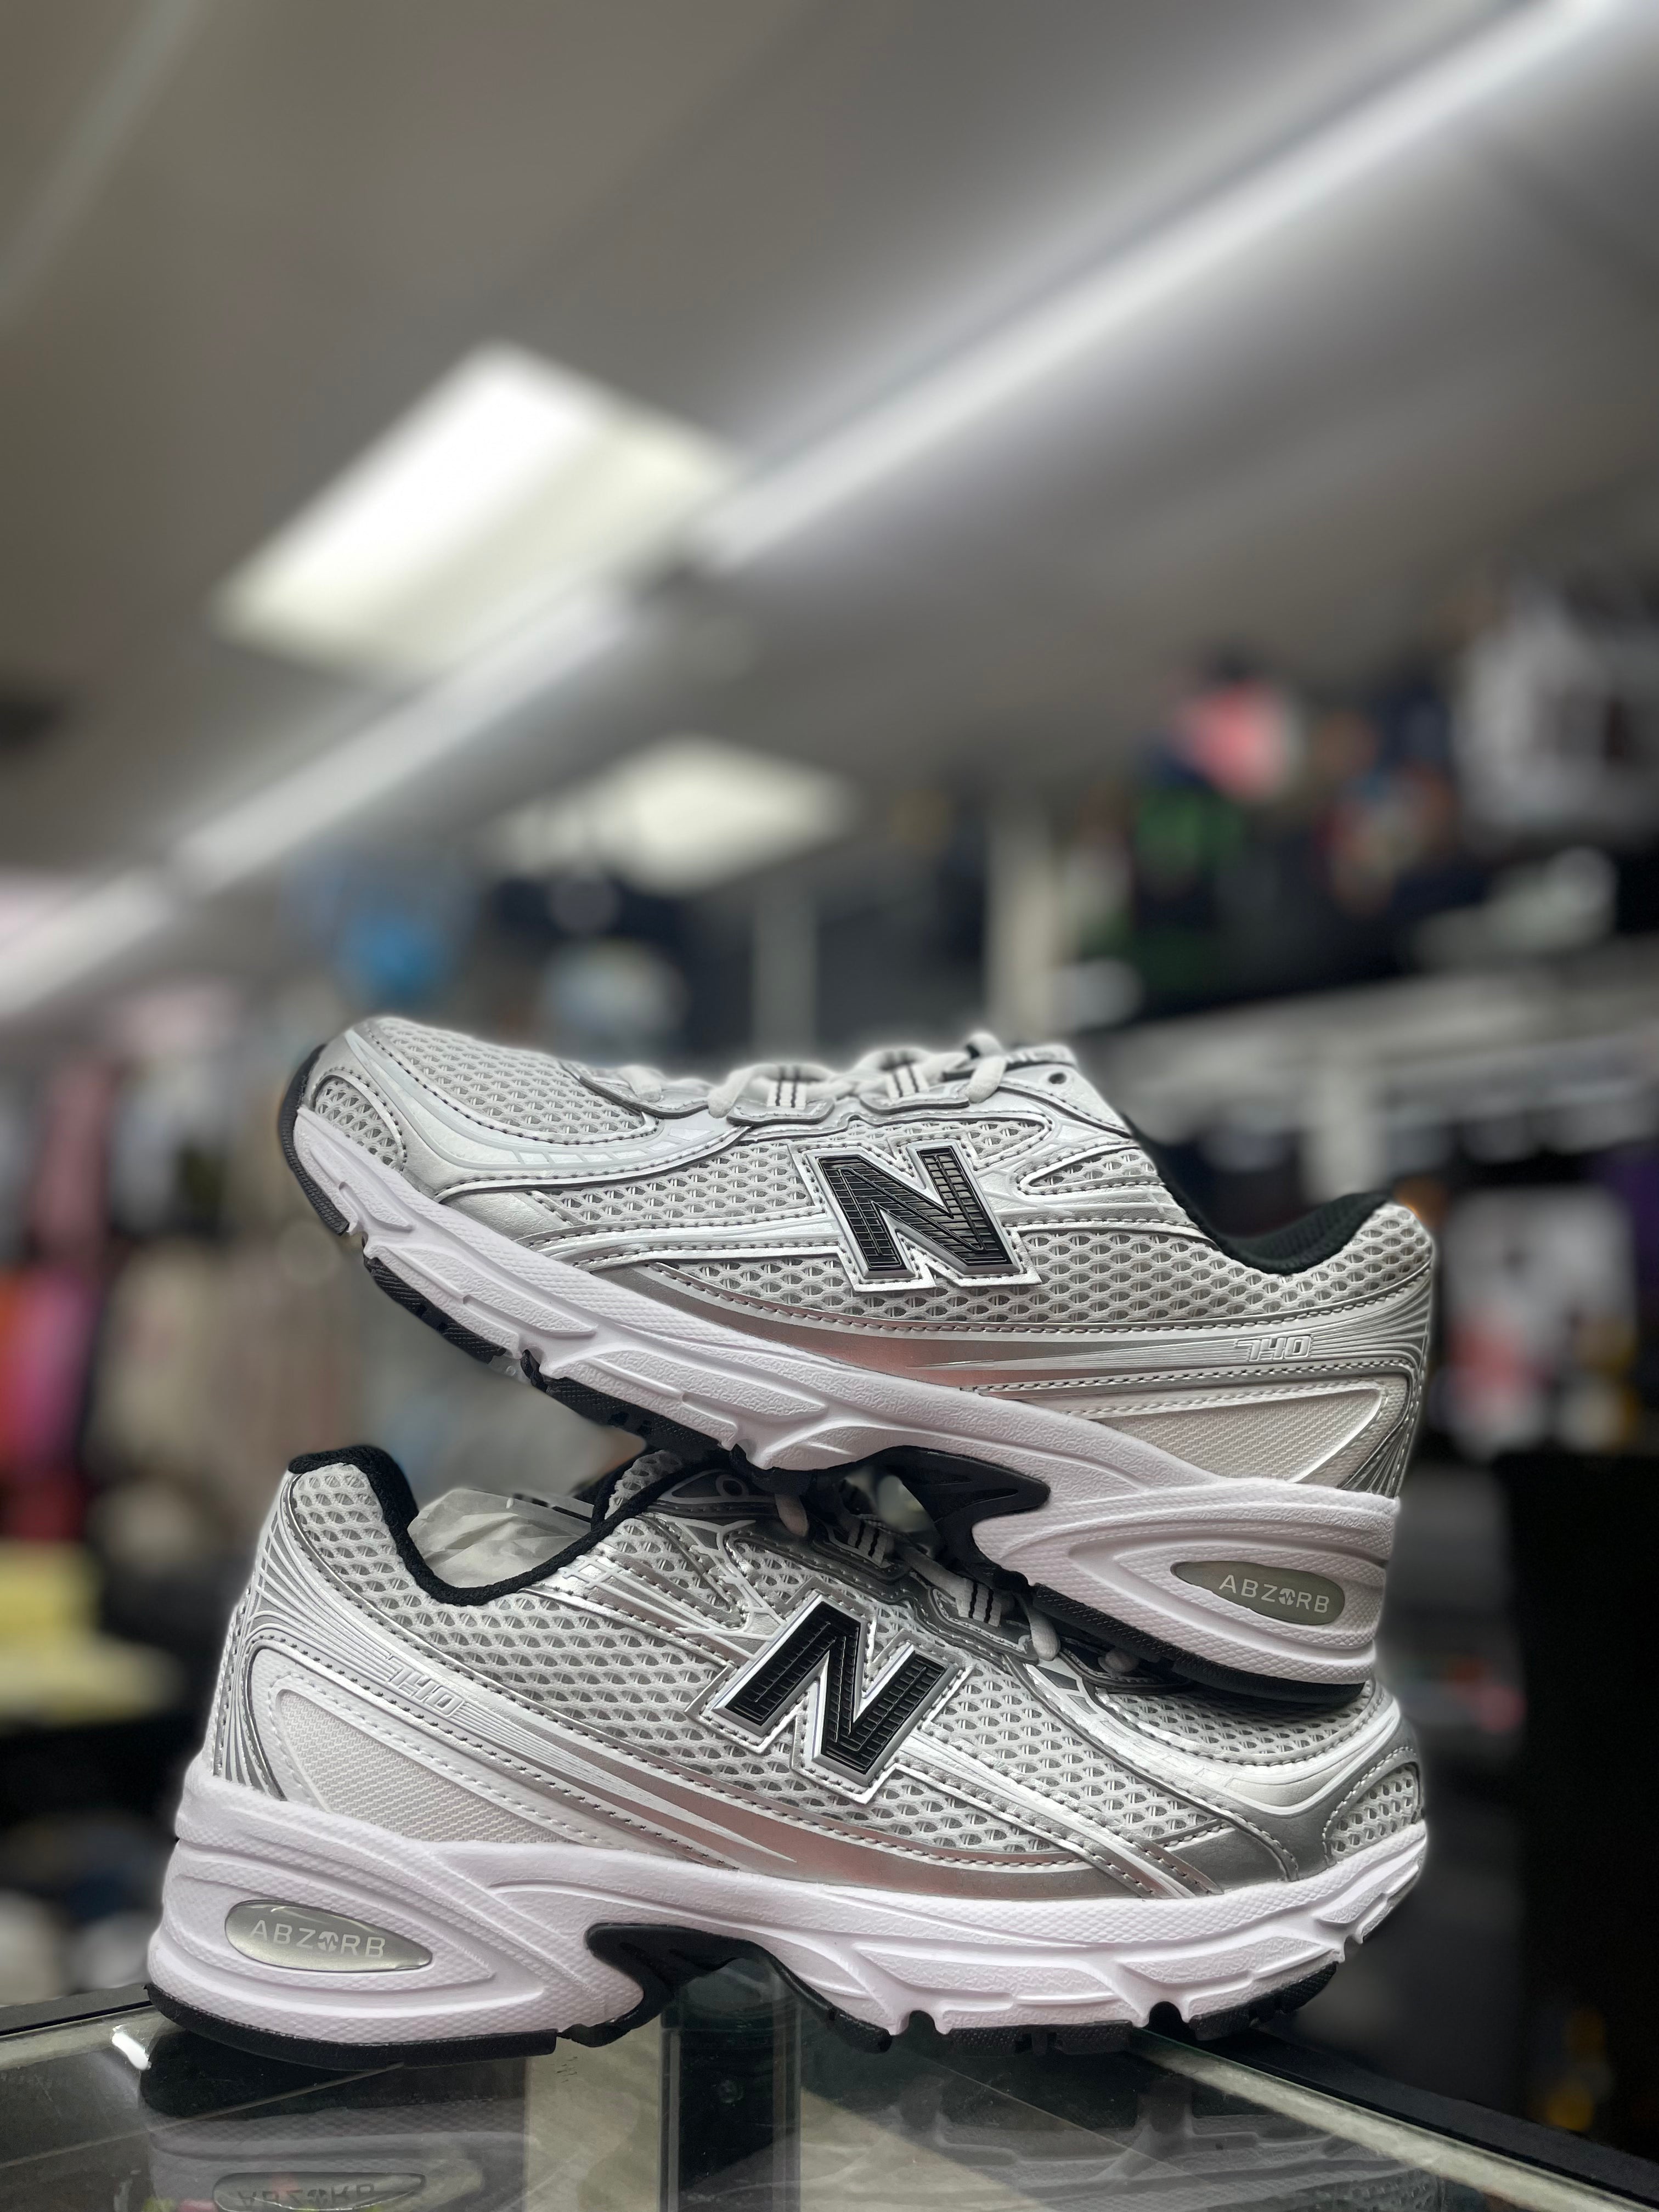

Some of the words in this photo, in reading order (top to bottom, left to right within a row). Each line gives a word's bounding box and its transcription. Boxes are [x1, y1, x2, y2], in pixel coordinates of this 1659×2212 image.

[805, 1141, 1025, 1279] N
[1235, 1335, 1312, 1362] 740
[1218, 1575, 1330, 1613] ABZORB
[388, 1655, 465, 1718] 740
[713, 1593, 958, 1787] N
[250, 1920, 386, 1958] ABZORB
